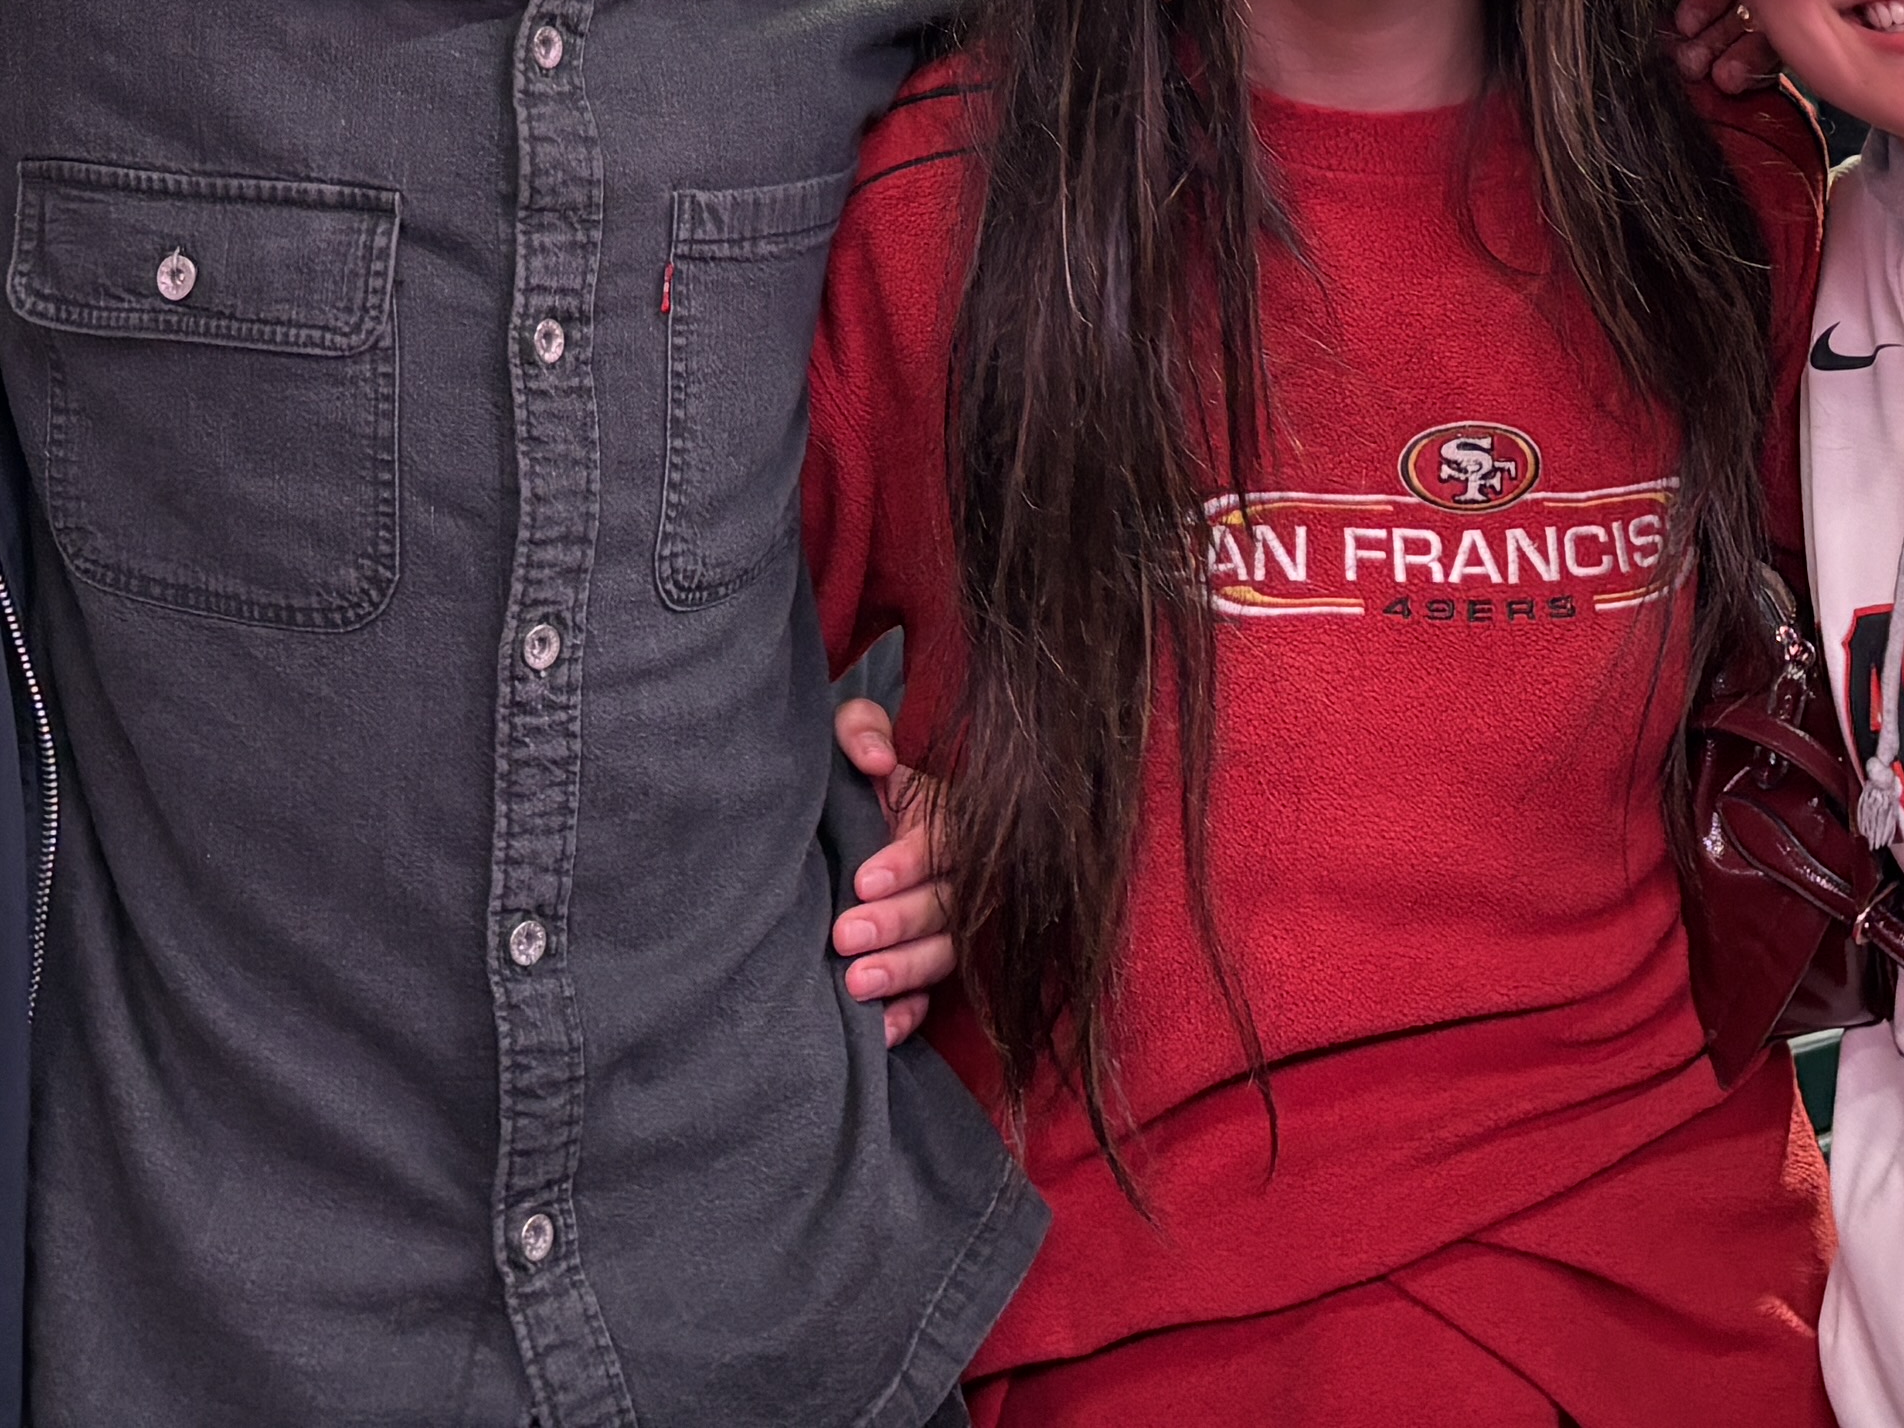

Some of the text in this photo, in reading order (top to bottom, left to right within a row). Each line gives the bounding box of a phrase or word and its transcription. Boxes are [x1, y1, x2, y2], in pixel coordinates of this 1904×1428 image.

[1439, 436, 1517, 505] SF
[1208, 513, 1664, 585] AN FRANCIS
[1382, 594, 1578, 623] 49ERS
